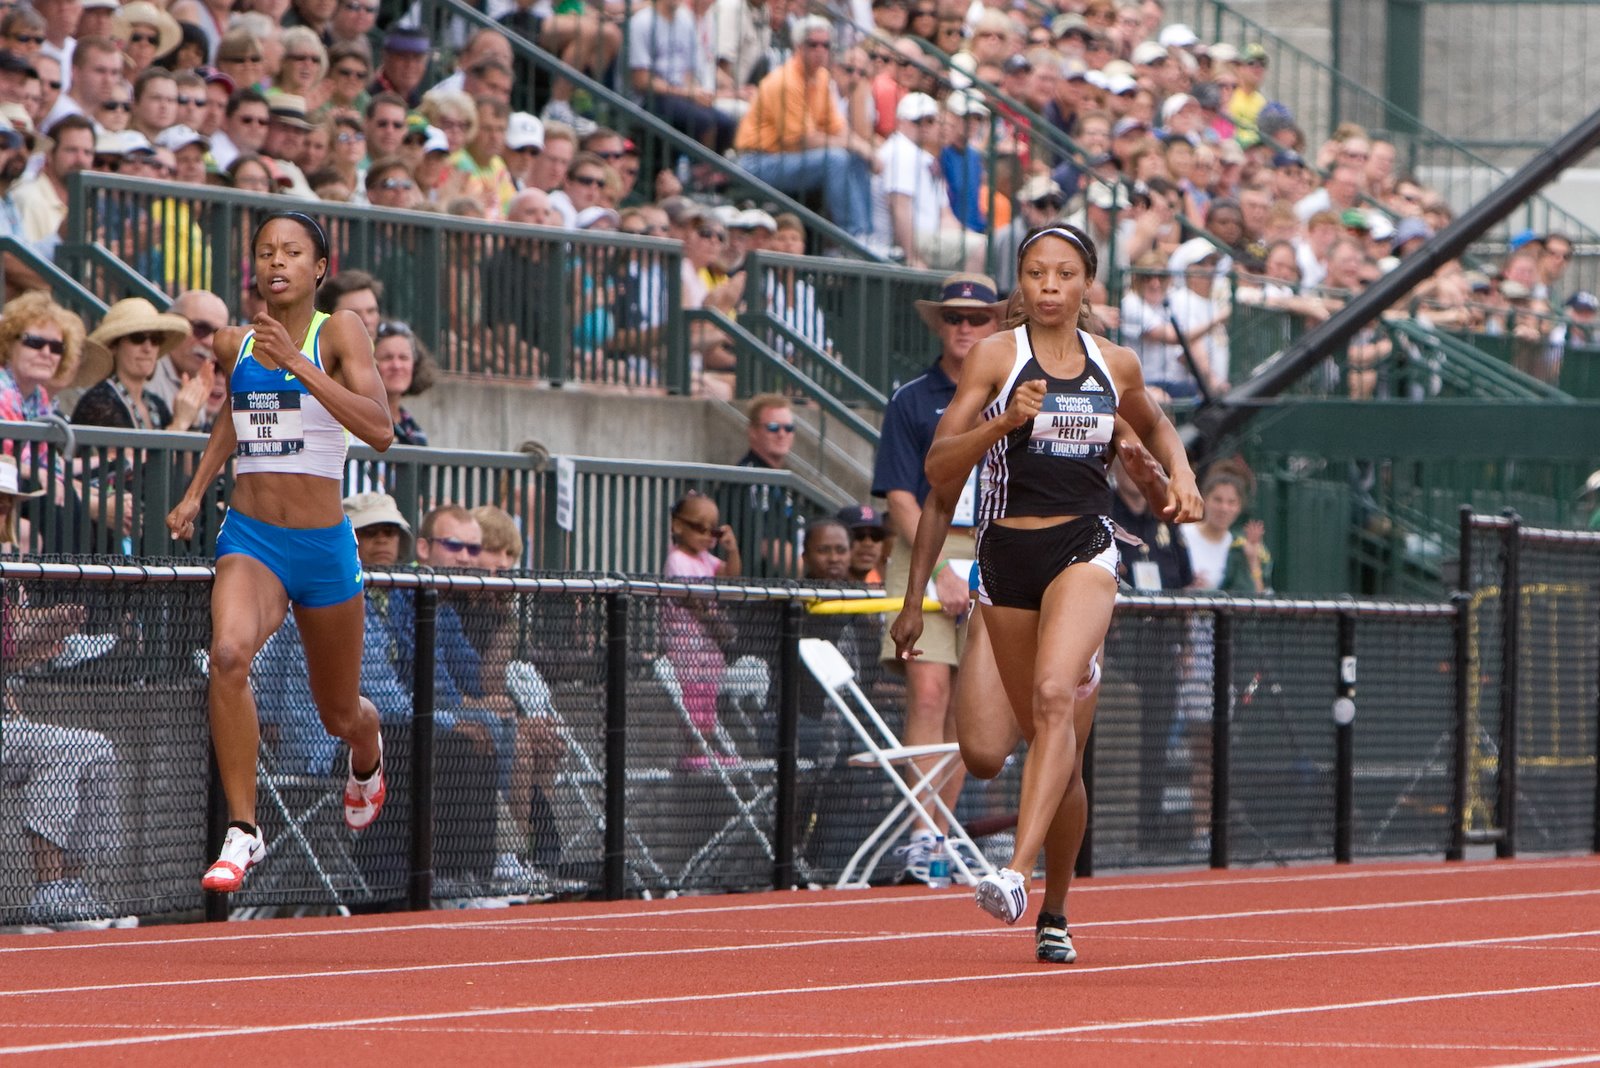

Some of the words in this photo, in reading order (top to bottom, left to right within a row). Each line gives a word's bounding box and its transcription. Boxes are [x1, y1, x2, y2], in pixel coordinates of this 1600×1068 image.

[247, 391, 278, 402] olympic
[1055, 394, 1091, 405] olympic
[250, 412, 278, 425] MUNA
[1051, 415, 1098, 429] ALLYSON
[257, 426, 272, 439] LEE
[1058, 428, 1088, 441] FELIX
